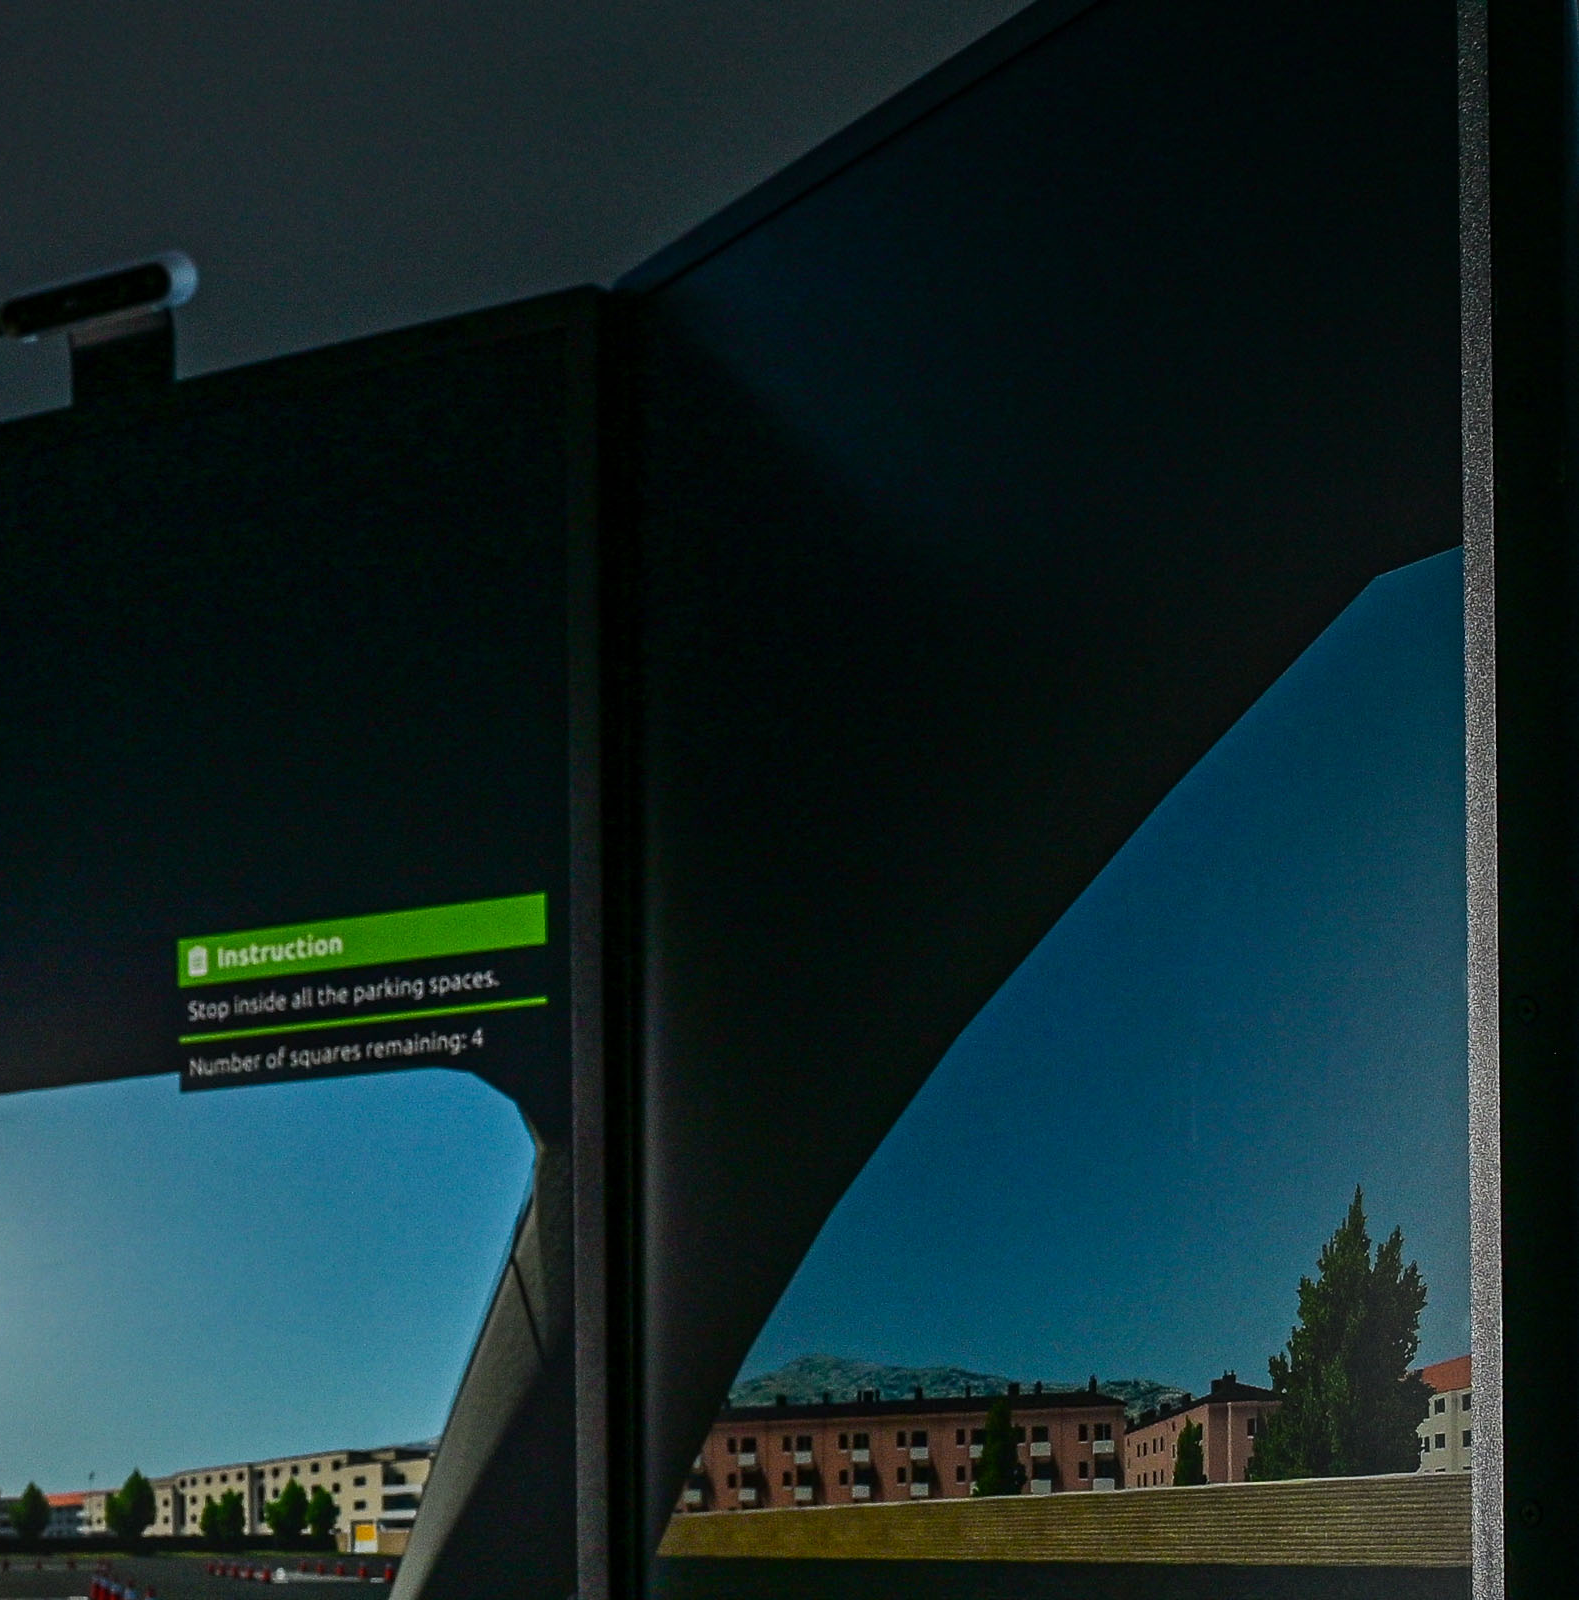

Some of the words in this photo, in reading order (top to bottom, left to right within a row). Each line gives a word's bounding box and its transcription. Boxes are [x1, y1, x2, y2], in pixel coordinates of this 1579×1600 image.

[217, 934, 344, 969] Instruction
[187, 999, 230, 1022] Stop
[233, 989, 287, 1015] inside
[291, 986, 314, 1010] all
[317, 984, 350, 1007] the
[353, 976, 425, 1006] parking
[428, 969, 500, 997] spaces.
[189, 1052, 262, 1077] Number
[265, 1045, 287, 1070] of
[290, 1043, 362, 1069] squares
[365, 1031, 468, 1056] remaining:
[471, 1026, 485, 1049] 4
